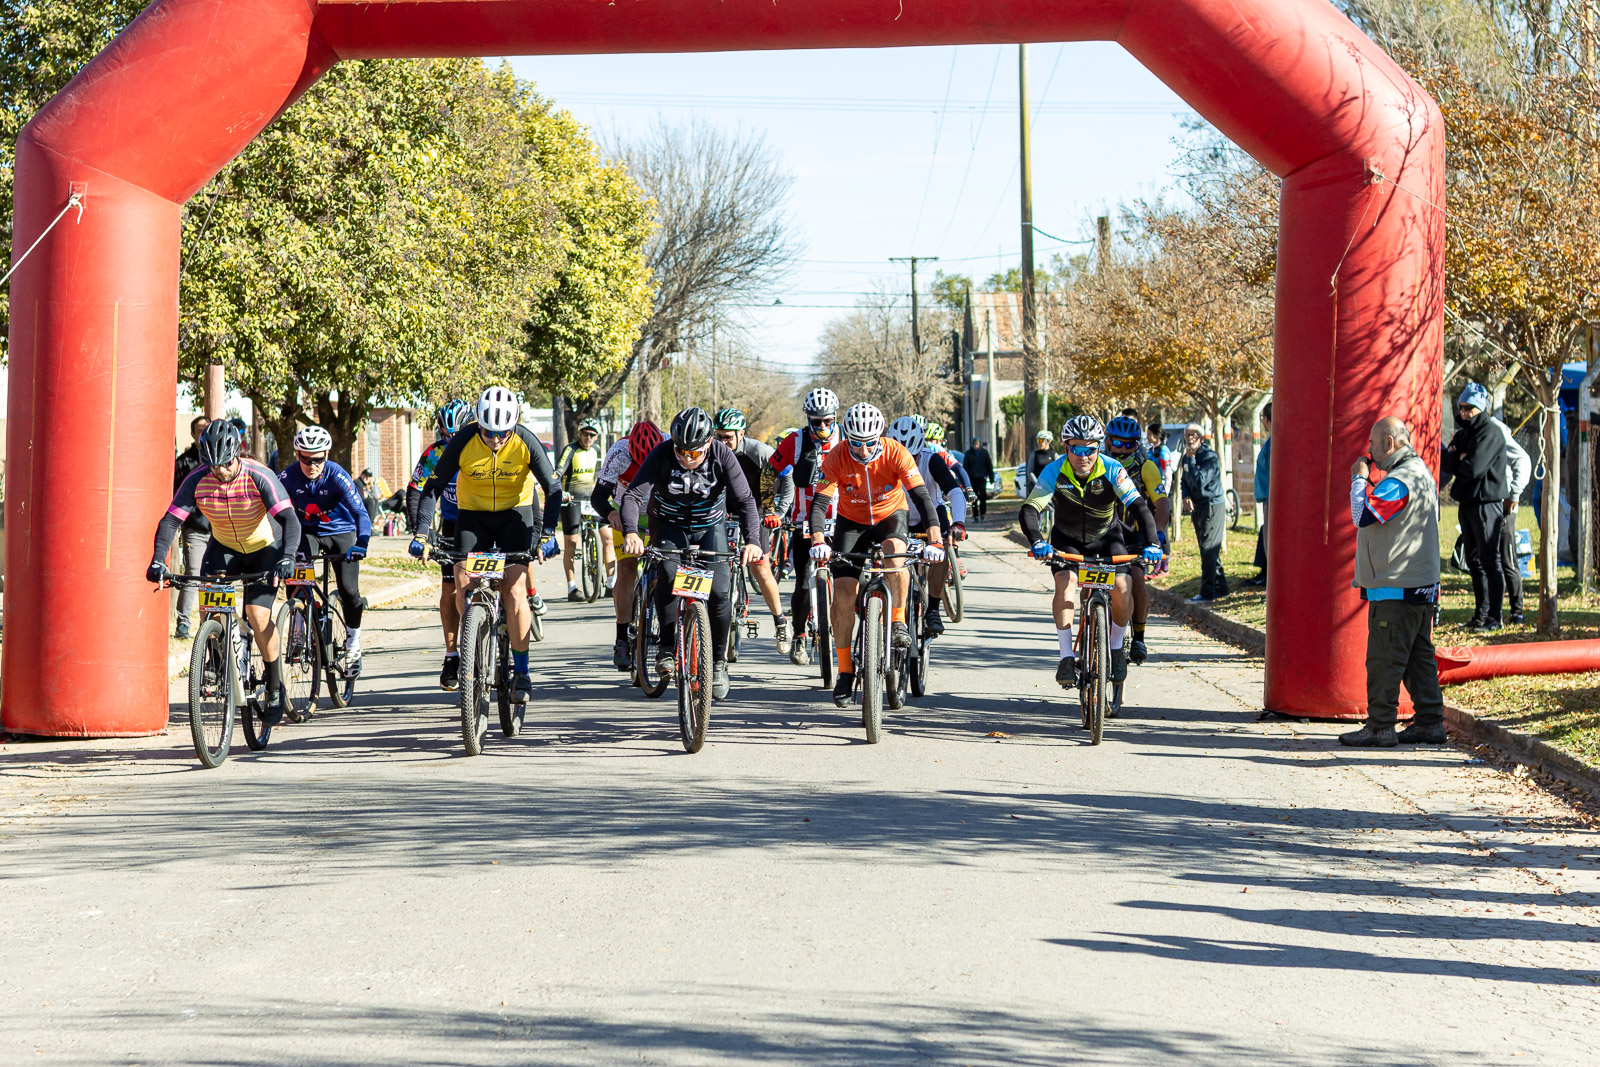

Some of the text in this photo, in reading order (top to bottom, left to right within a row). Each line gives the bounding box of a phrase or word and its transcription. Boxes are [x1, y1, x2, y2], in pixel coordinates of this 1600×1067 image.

[472, 559, 499, 571] 68
[682, 575, 704, 591] 91
[1084, 571, 1110, 584] 58
[204, 592, 232, 606] 144
